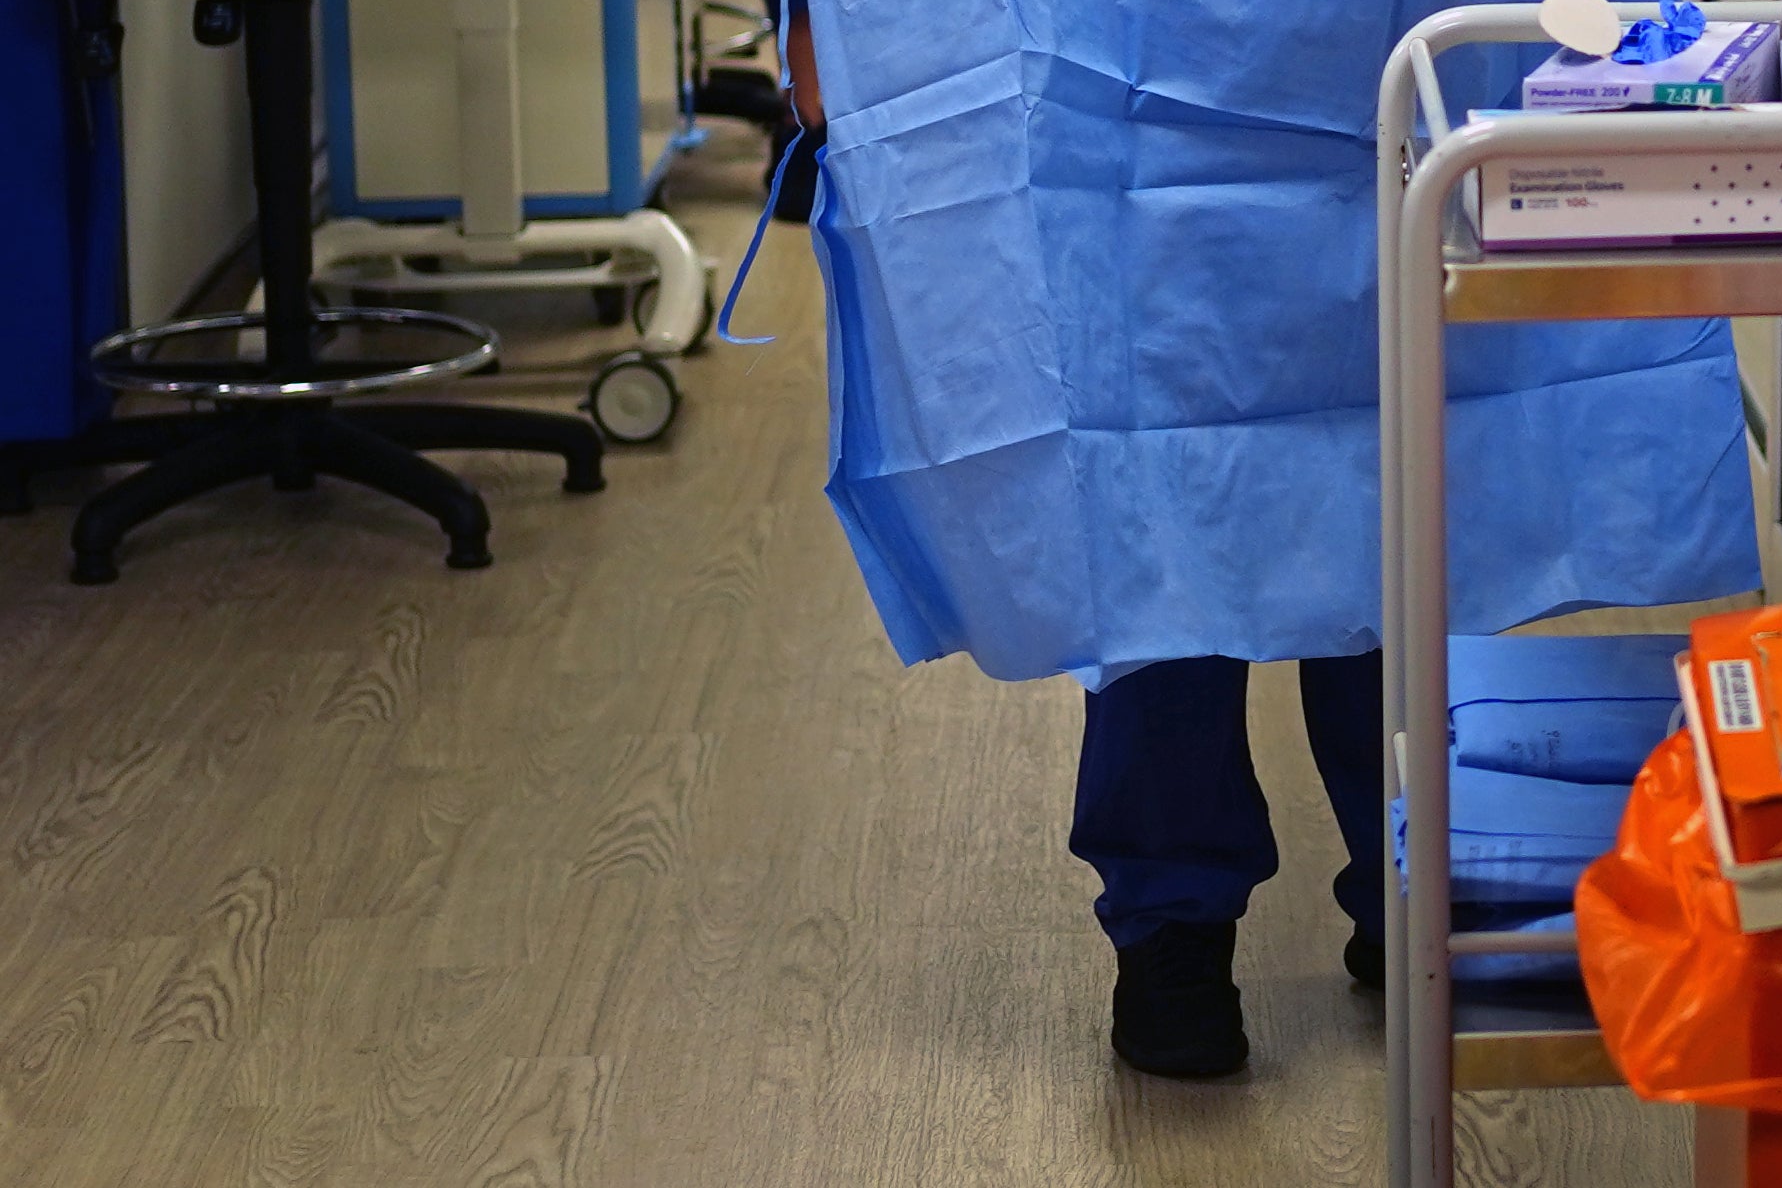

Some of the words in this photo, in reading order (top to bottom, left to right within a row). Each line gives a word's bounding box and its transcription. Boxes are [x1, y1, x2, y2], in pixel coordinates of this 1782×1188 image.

[1696, 87, 1713, 104] M
[1510, 182, 1583, 194] Examination
[1584, 180, 1624, 192] Gloves
